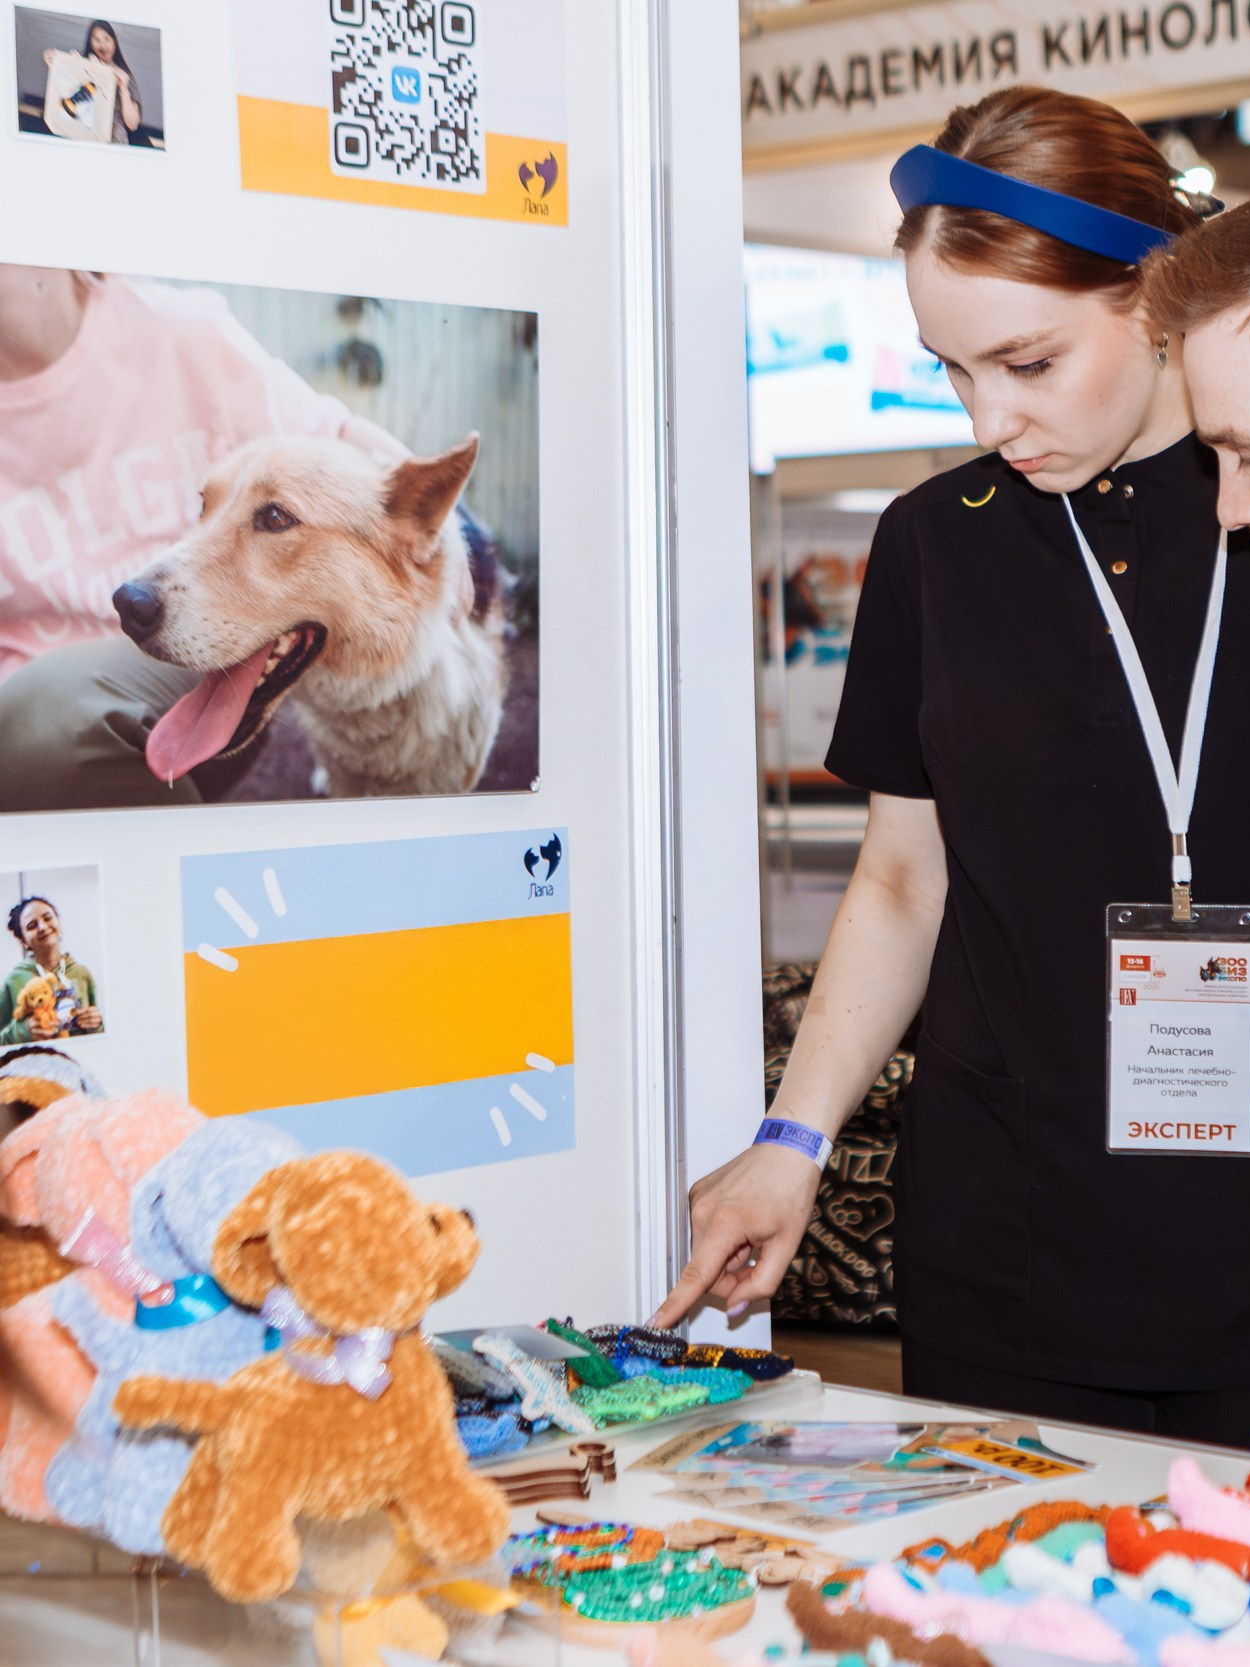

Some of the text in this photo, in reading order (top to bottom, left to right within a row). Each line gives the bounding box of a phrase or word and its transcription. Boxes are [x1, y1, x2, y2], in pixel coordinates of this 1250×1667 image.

[744, 29, 1020, 120] АКАДЕМИЯ
[522, 197, 549, 217] Лапа
[527, 882, 555, 901] Лапа
[1149, 1023, 1212, 1038] Подусова
[1147, 1045, 1214, 1057] Анастасия
[1127, 1064, 1237, 1077] Начальник лечебно-
[1132, 1077, 1229, 1088] диагностического
[1160, 1088, 1198, 1098] отдела
[783, 1125, 824, 1151] ЭКСПО
[1127, 1121, 1237, 1141] ЭКСПЕРТ
[843, 1252, 877, 1278] DOG
